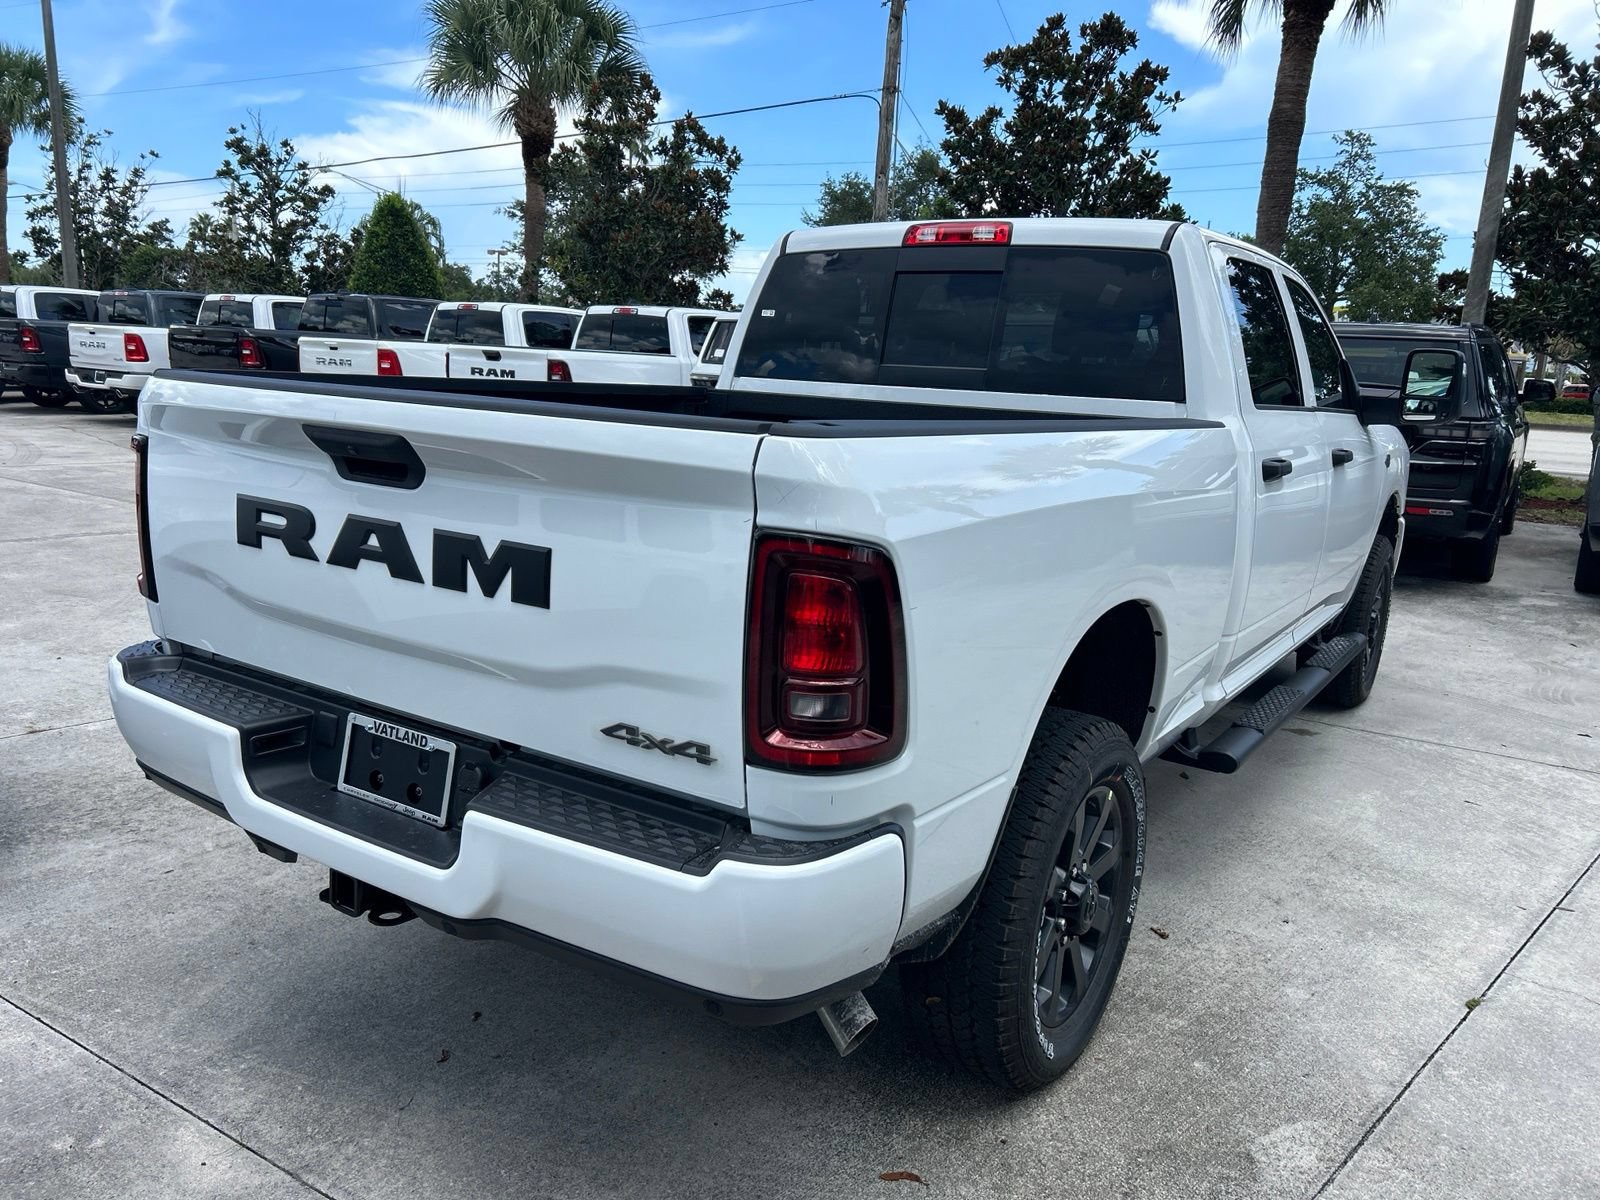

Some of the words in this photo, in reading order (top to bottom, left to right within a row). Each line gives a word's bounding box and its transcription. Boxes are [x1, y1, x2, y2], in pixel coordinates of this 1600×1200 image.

[315, 356, 352, 367] RAM
[470, 366, 516, 379] RAM
[236, 493, 552, 610] RAM
[373, 720, 428, 748] VATLAND
